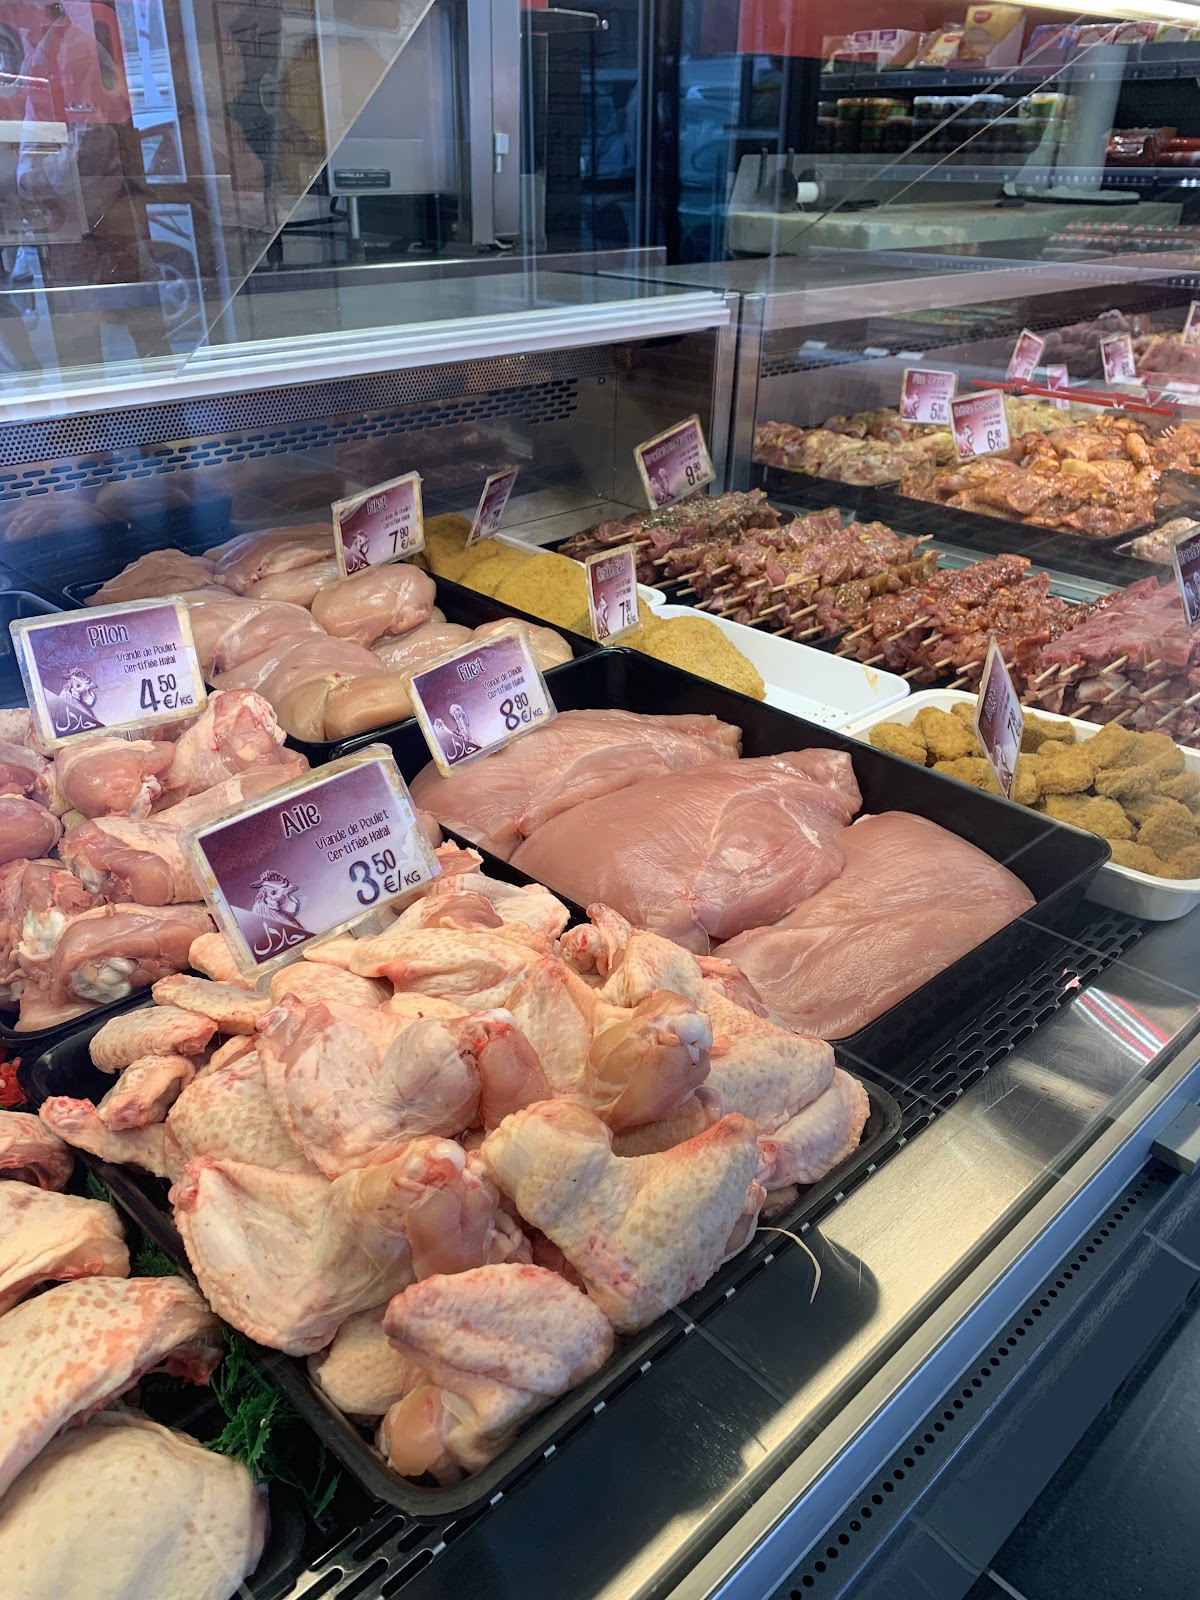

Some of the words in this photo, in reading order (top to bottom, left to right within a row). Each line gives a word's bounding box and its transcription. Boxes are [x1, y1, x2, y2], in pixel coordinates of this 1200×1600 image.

[987, 430, 996, 450] 6
[686, 466, 695, 486] 9
[366, 495, 388, 515] Filet
[388, 530, 399, 554] 7
[618, 601, 625, 627] 7
[87, 624, 129, 648] Pilon
[116, 650, 142, 662] Viande
[142, 647, 152, 657] de
[153, 642, 178, 656] Poulet
[124, 658, 158, 674] Certifiée
[158, 654, 176, 667] Halal
[457, 657, 486, 682] Filet
[500, 673, 508, 681] de
[140, 678, 161, 712] 4
[158, 673, 178, 692] 50
[56, 706, 97, 732] حلال
[500, 698, 520, 730] 8
[280, 804, 321, 838] Aile
[314, 830, 348, 850] Viande
[348, 824, 359, 836] de
[359, 809, 390, 831] Poulet
[327, 836, 369, 862] Certifiée
[370, 824, 391, 842] Halal
[349, 860, 380, 906] 3
[373, 848, 397, 876] 50
[254, 922, 306, 956] حلال
